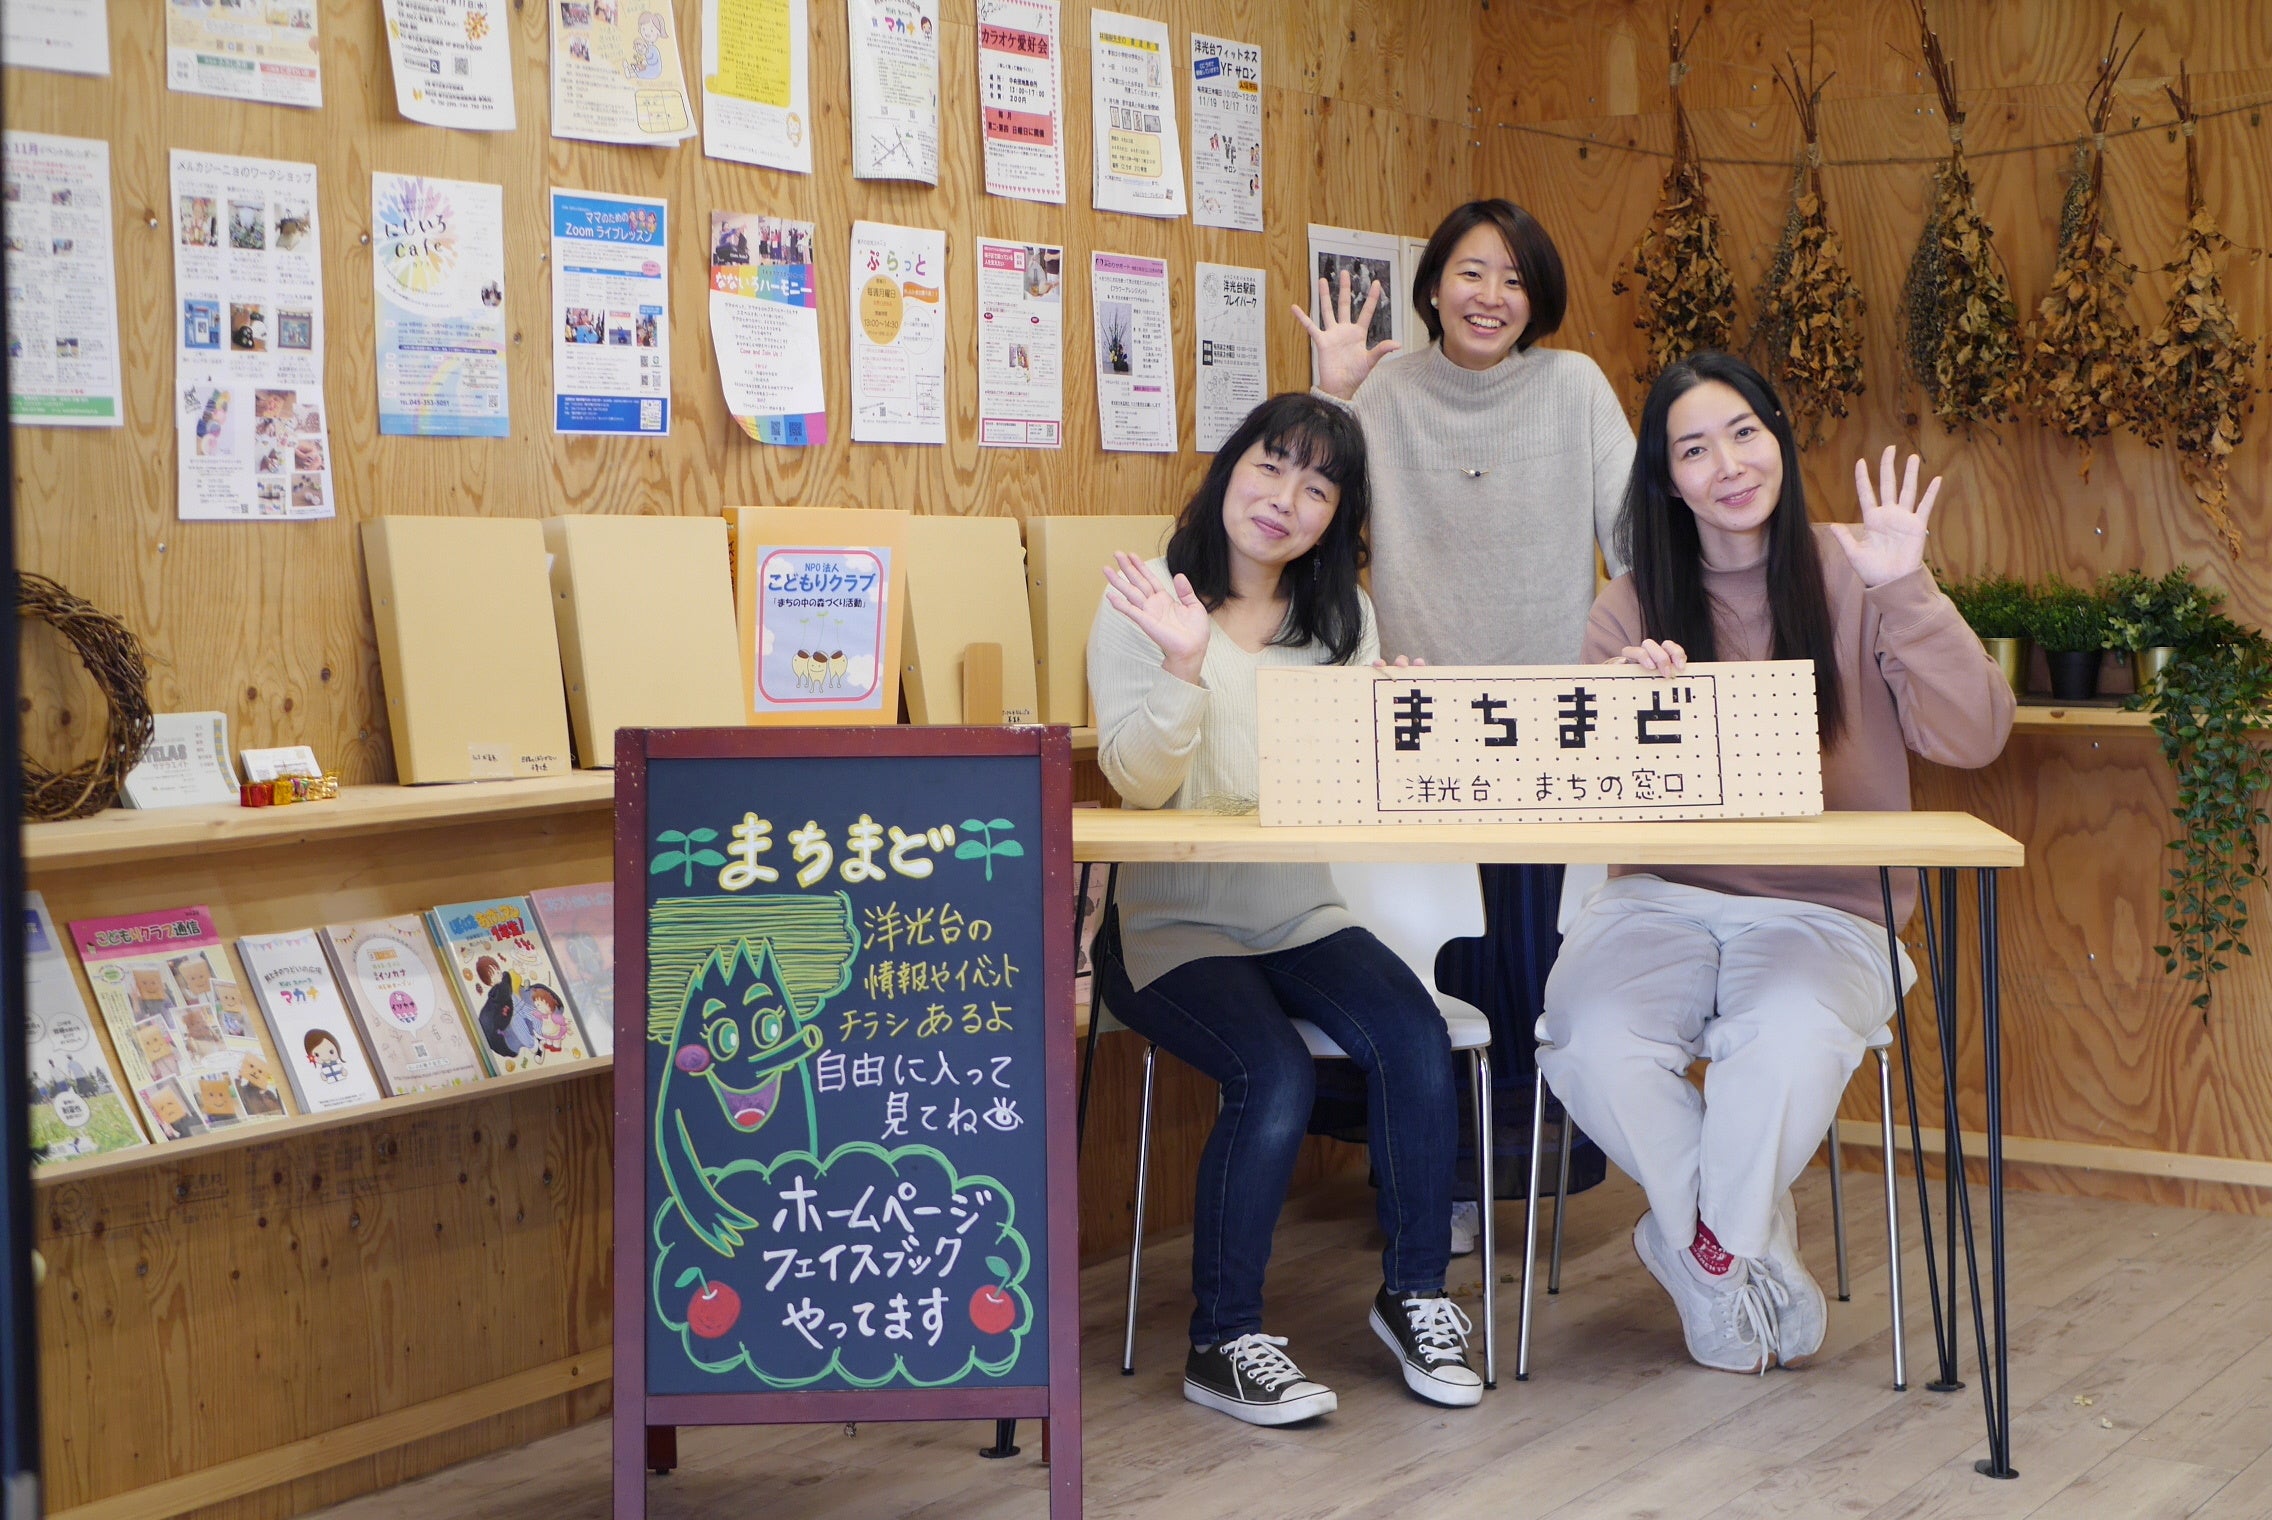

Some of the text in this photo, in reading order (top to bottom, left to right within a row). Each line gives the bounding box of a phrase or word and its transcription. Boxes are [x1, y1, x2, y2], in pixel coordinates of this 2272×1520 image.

[982, 28, 1048, 55] カラオケ愛好会
[1194, 40, 1258, 63] 洋光台フィットネス
[1220, 62, 1256, 80] YF サロン
[177, 160, 312, 184] メルカジーニョのワークショップ
[585, 210, 629, 224] ママのための
[566, 222, 653, 244] Zoom ライブレッスン
[866, 251, 926, 276] ぷらっと
[716, 271, 812, 297] なないろハーモニー
[1223, 280, 1256, 296] 洋光台駅前
[804, 563, 840, 572] NPO 法人
[768, 574, 876, 592] こどもりクラブ
[773, 598, 866, 608] 「まちの中の森づくり活動」
[1394, 687, 1692, 751] まちまど
[1406, 768, 1685, 804] 洋光台 まちの窓口
[718, 812, 956, 891] まちまど
[95, 919, 201, 947] こどもりクラブ通信
[863, 901, 992, 952] 洋光台の
[864, 953, 1020, 1000] 情報やイベント
[280, 986, 320, 1004] マカナ
[839, 1000, 1014, 1042] チラシ あるよ
[816, 1050, 1012, 1094] 自由に入って
[881, 1091, 978, 1140] 見てね
[772, 1175, 992, 1234] ホームページ
[762, 1234, 962, 1292] フェイスブック
[782, 1286, 949, 1350] やってます
